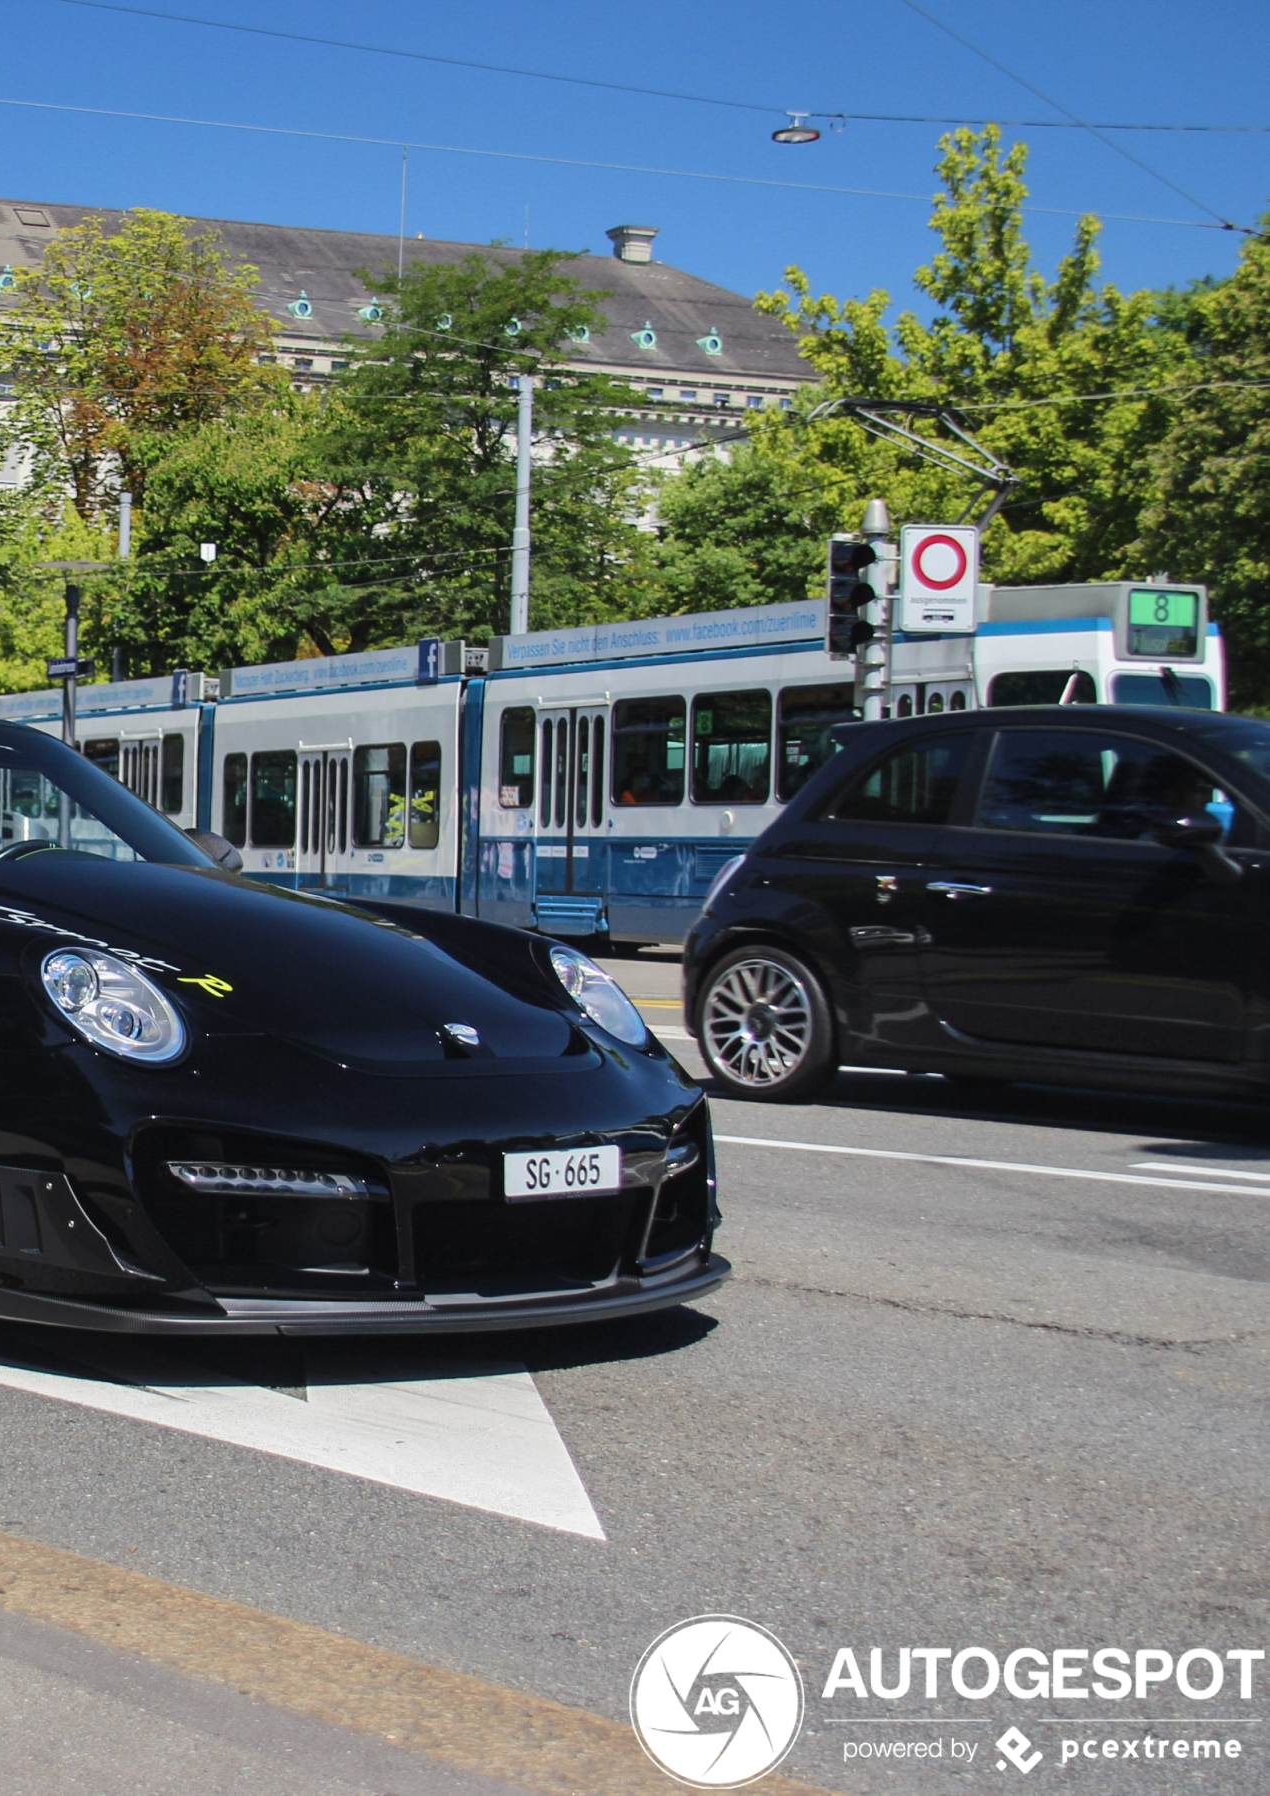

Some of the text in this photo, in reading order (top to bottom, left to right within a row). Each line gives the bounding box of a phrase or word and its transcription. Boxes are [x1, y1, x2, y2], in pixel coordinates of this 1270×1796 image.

[910, 597, 968, 606] ausgenommen
[1154, 593, 1170, 623] 8
[507, 610, 817, 660] Verpassen Sie nicht den Anschluss: www.facebook.com/zuerilinie
[176, 973, 234, 998] R
